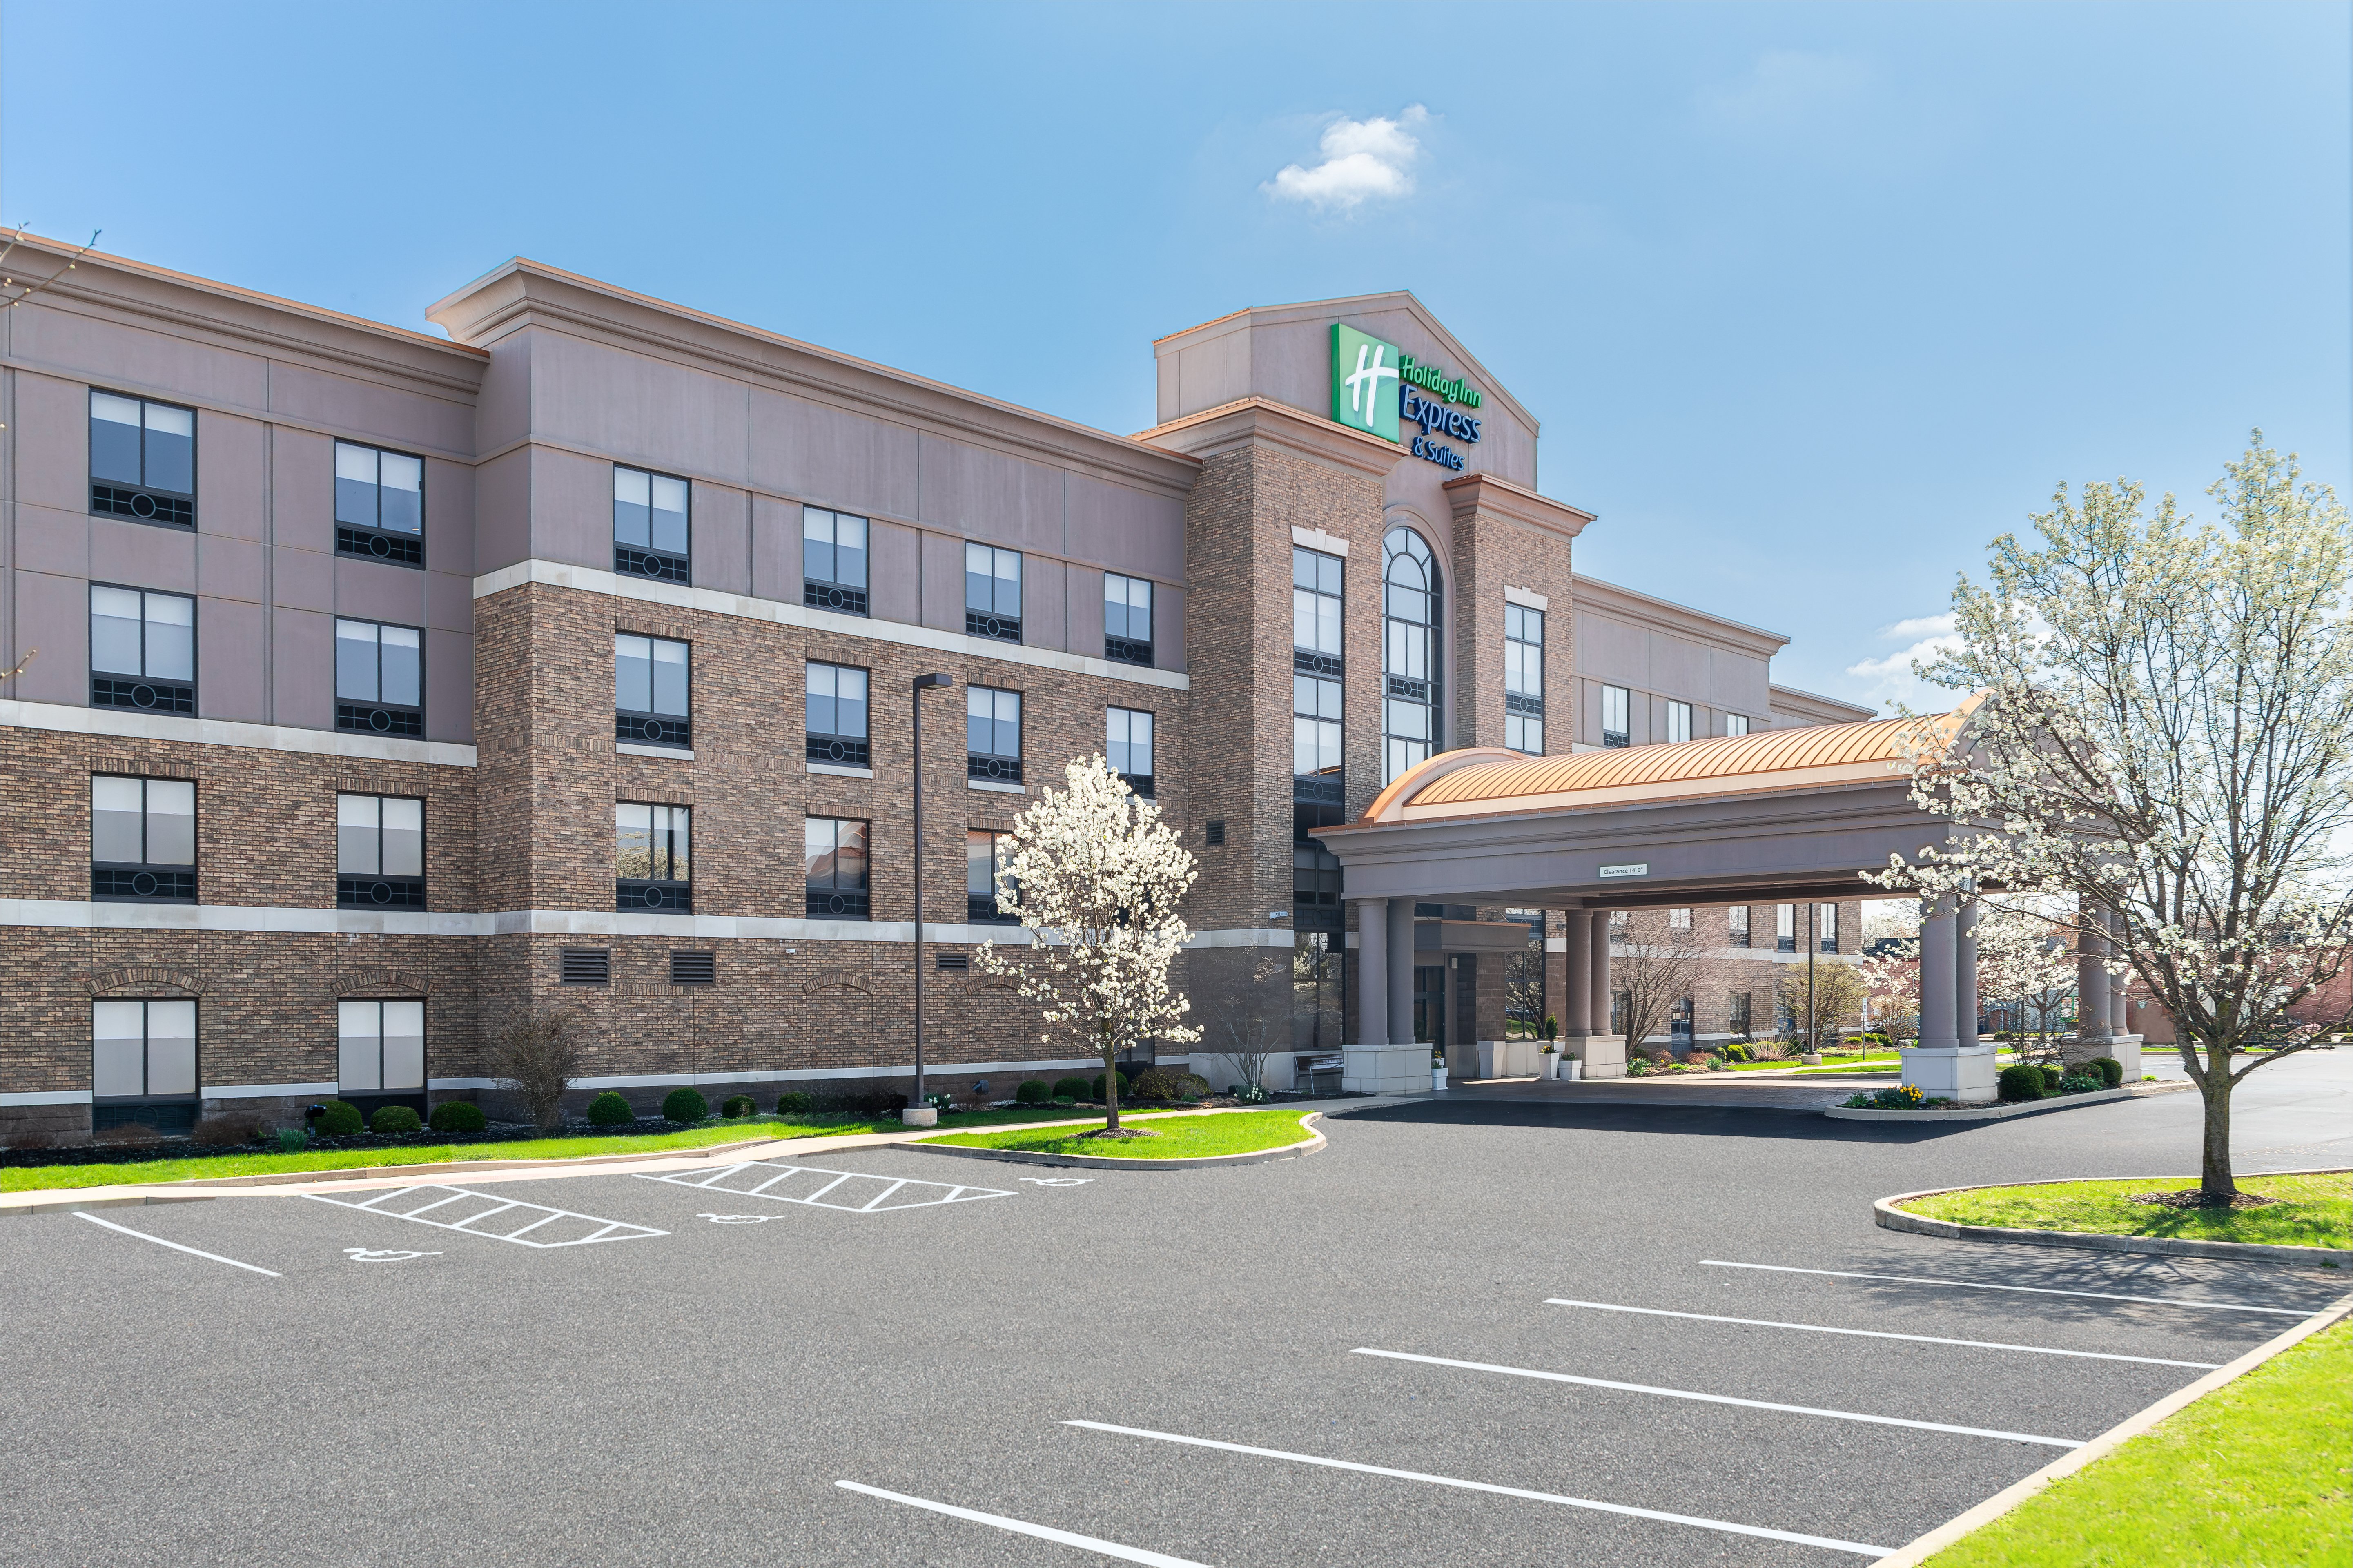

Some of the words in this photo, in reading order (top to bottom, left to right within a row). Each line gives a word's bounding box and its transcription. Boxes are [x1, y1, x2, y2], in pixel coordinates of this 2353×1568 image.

[1402, 354, 1458, 402] Holiday
[1457, 378, 1481, 408] Inn
[1402, 384, 1482, 443] Express
[1413, 436, 1424, 456] &
[1426, 441, 1465, 471] Suites
